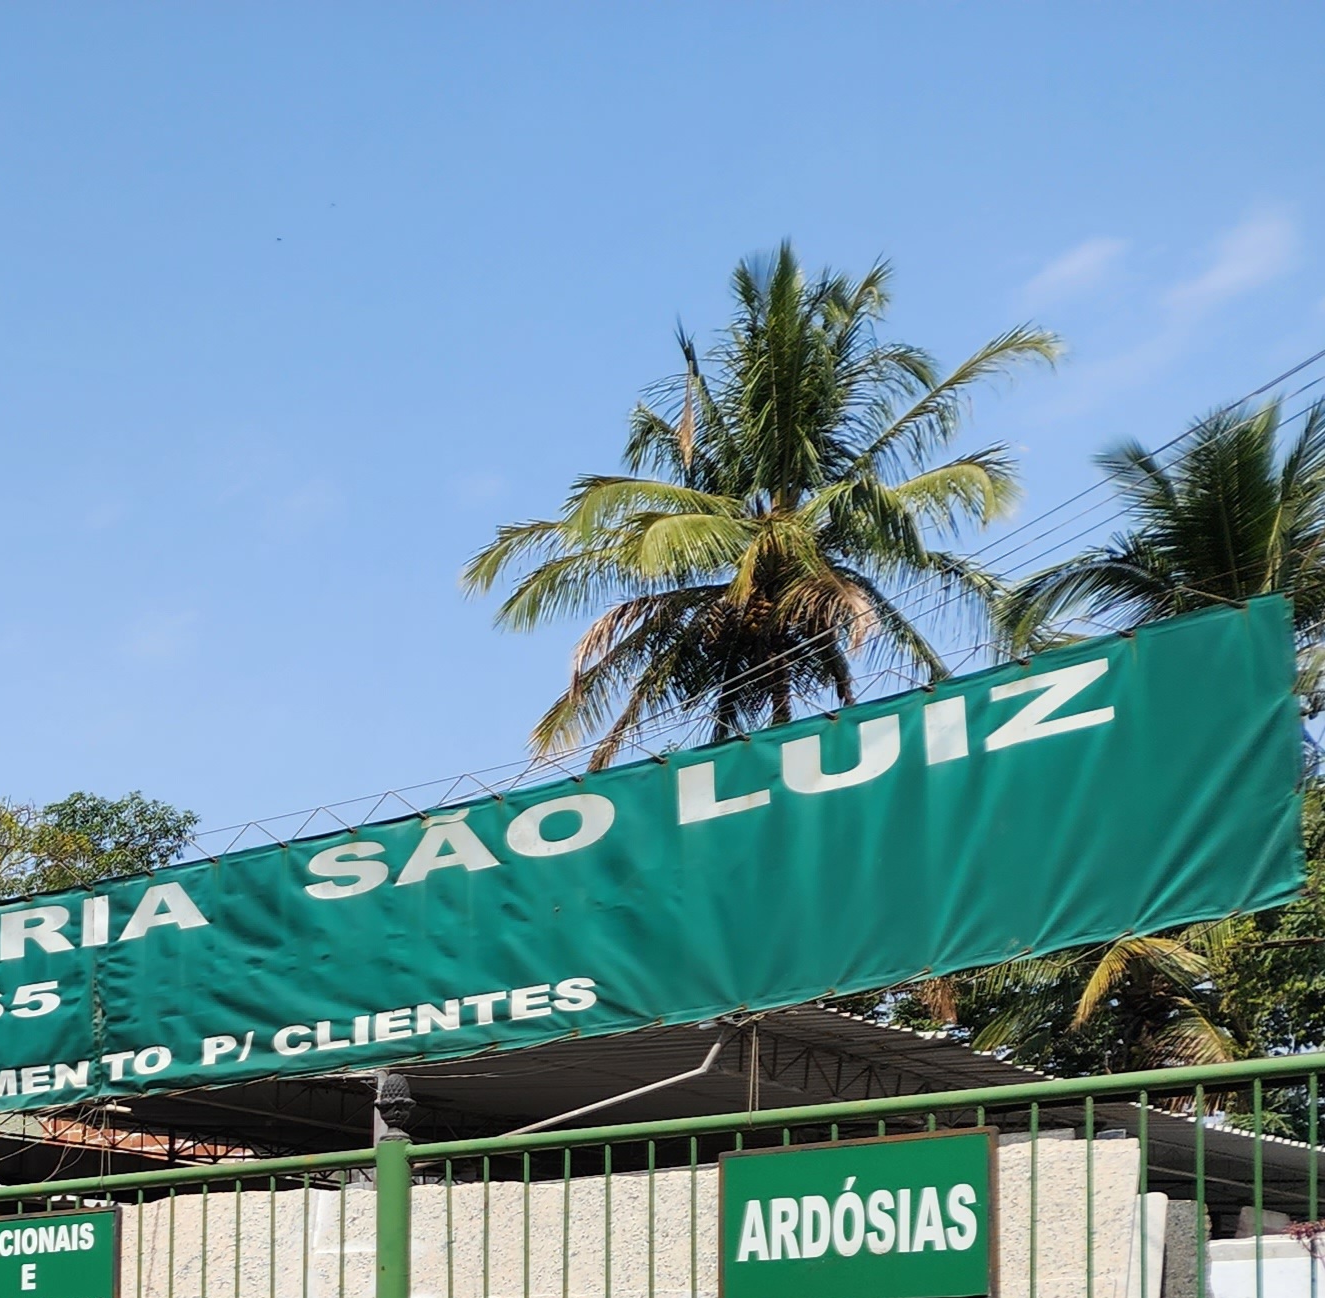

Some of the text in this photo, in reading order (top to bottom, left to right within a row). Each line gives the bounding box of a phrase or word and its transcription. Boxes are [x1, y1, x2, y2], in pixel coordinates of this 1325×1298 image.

[304, 794, 616, 899] SÃO
[678, 658, 1115, 824] LUIZ
[201, 1031, 255, 1065] P/
[273, 978, 598, 1056] CLIENTES
[735, 1176, 977, 1262] ARDÓSIAS
[20, 1263, 37, 1291] E
